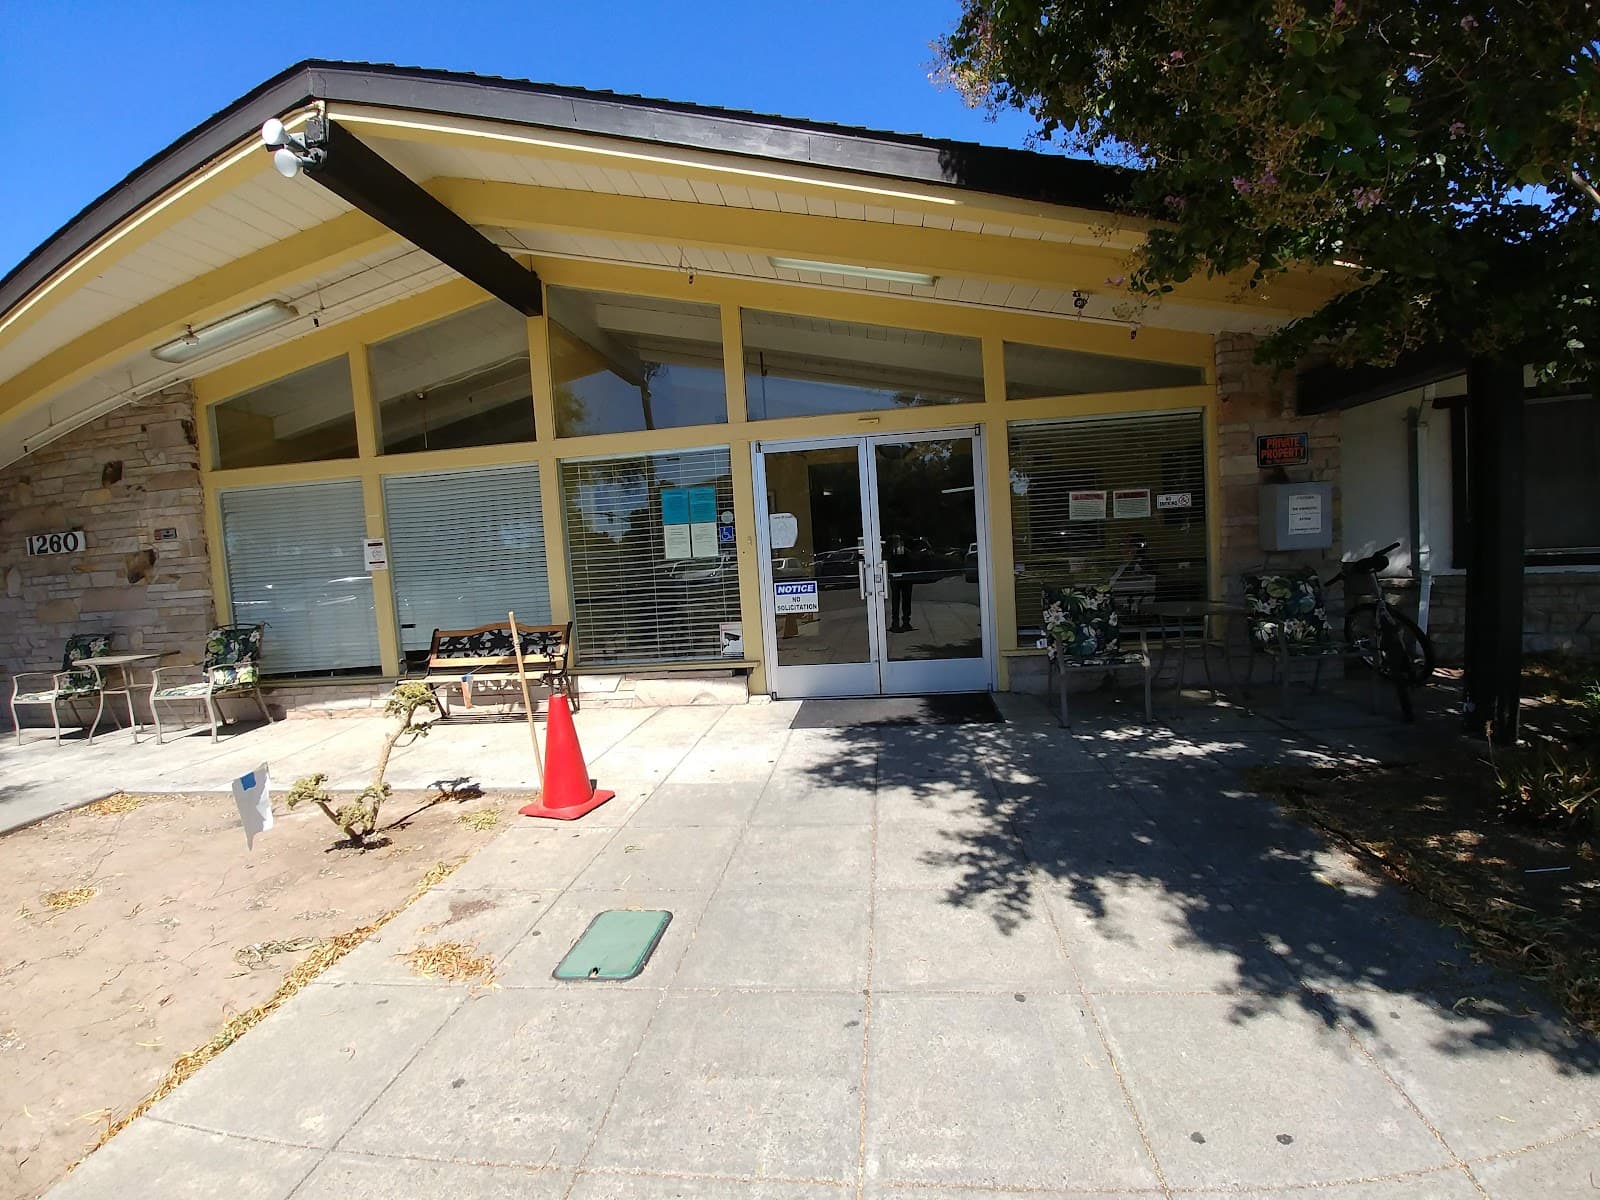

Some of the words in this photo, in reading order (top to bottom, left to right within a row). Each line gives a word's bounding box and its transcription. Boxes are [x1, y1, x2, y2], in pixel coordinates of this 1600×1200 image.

[1266, 436, 1299, 449] PRIVATE
[1261, 447, 1304, 459] PROPERTY
[29, 532, 79, 555] 1260
[777, 584, 814, 593] NOTICE
[777, 603, 817, 611] SOLICITATION
